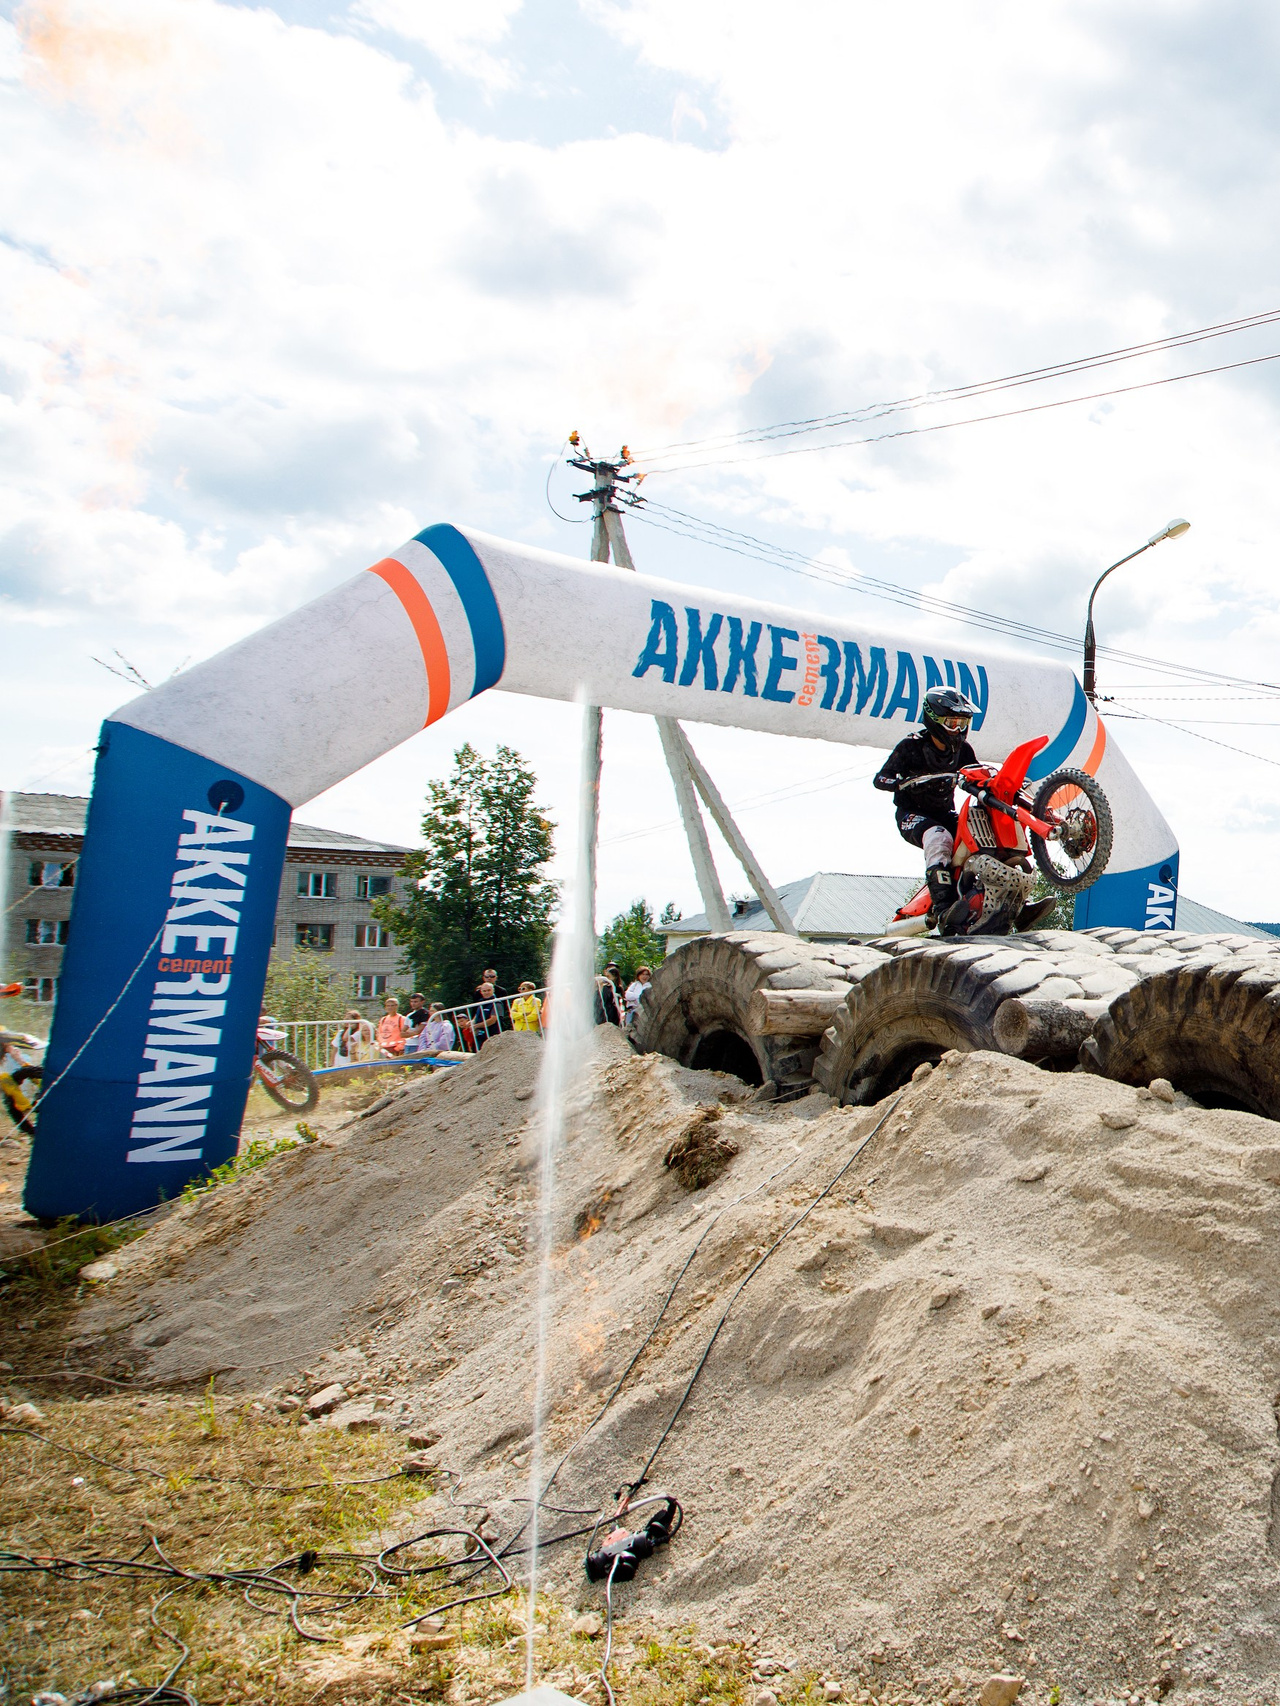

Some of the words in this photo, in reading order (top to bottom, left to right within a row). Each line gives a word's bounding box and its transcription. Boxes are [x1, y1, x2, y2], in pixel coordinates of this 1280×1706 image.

[631, 598, 989, 732] AKKERMANN
[797, 631, 820, 707] cement
[1144, 882, 1175, 931] AK
[126, 809, 256, 1163] AKKERMANN
[157, 956, 233, 974] cement
